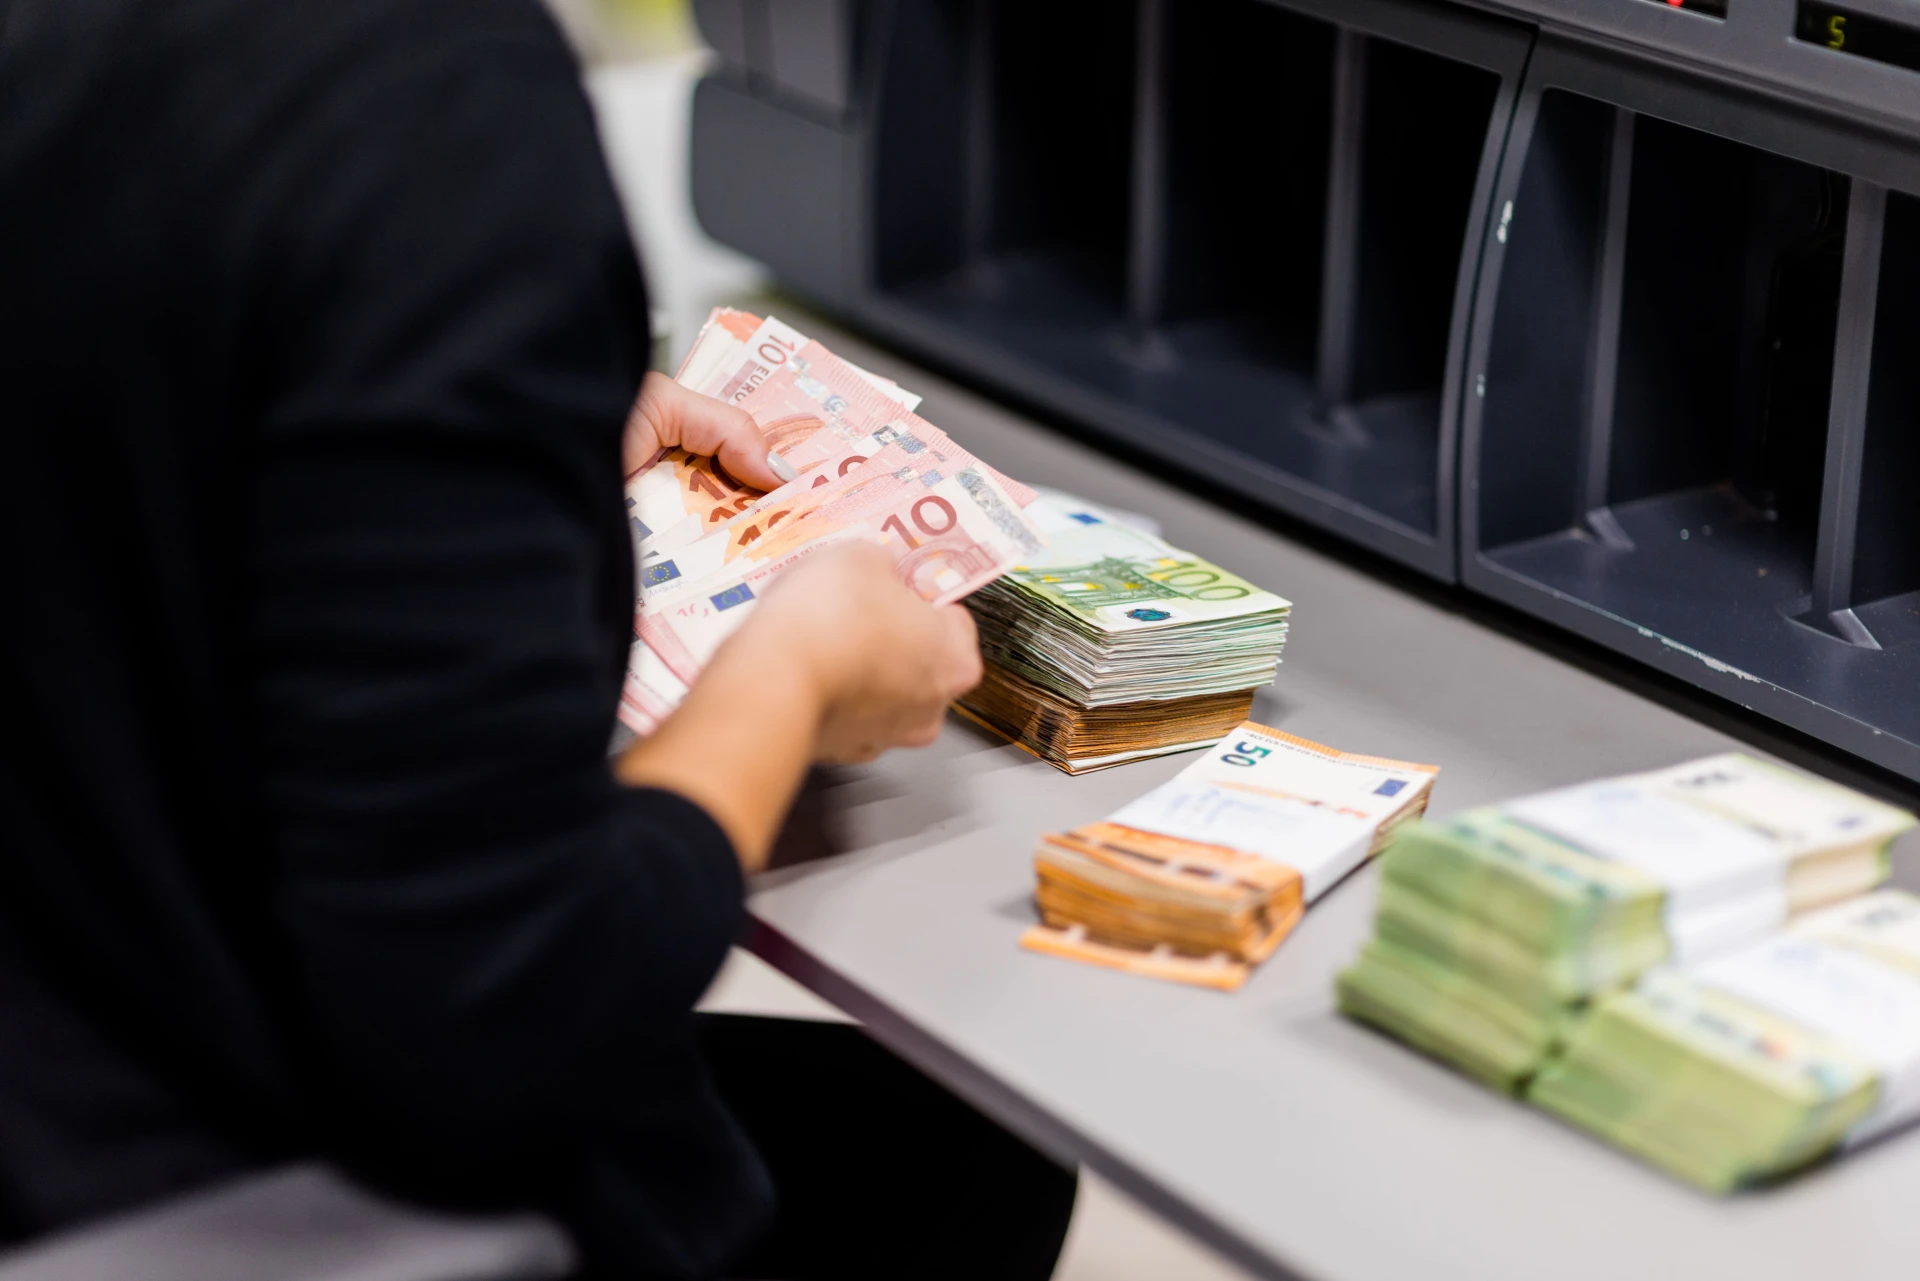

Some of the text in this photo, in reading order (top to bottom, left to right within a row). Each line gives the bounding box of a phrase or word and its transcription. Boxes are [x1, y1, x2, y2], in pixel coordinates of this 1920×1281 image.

[1828, 15, 1847, 49] 5
[758, 334, 796, 365] 10
[880, 495, 958, 551] 10
[1220, 741, 1273, 767] 50
